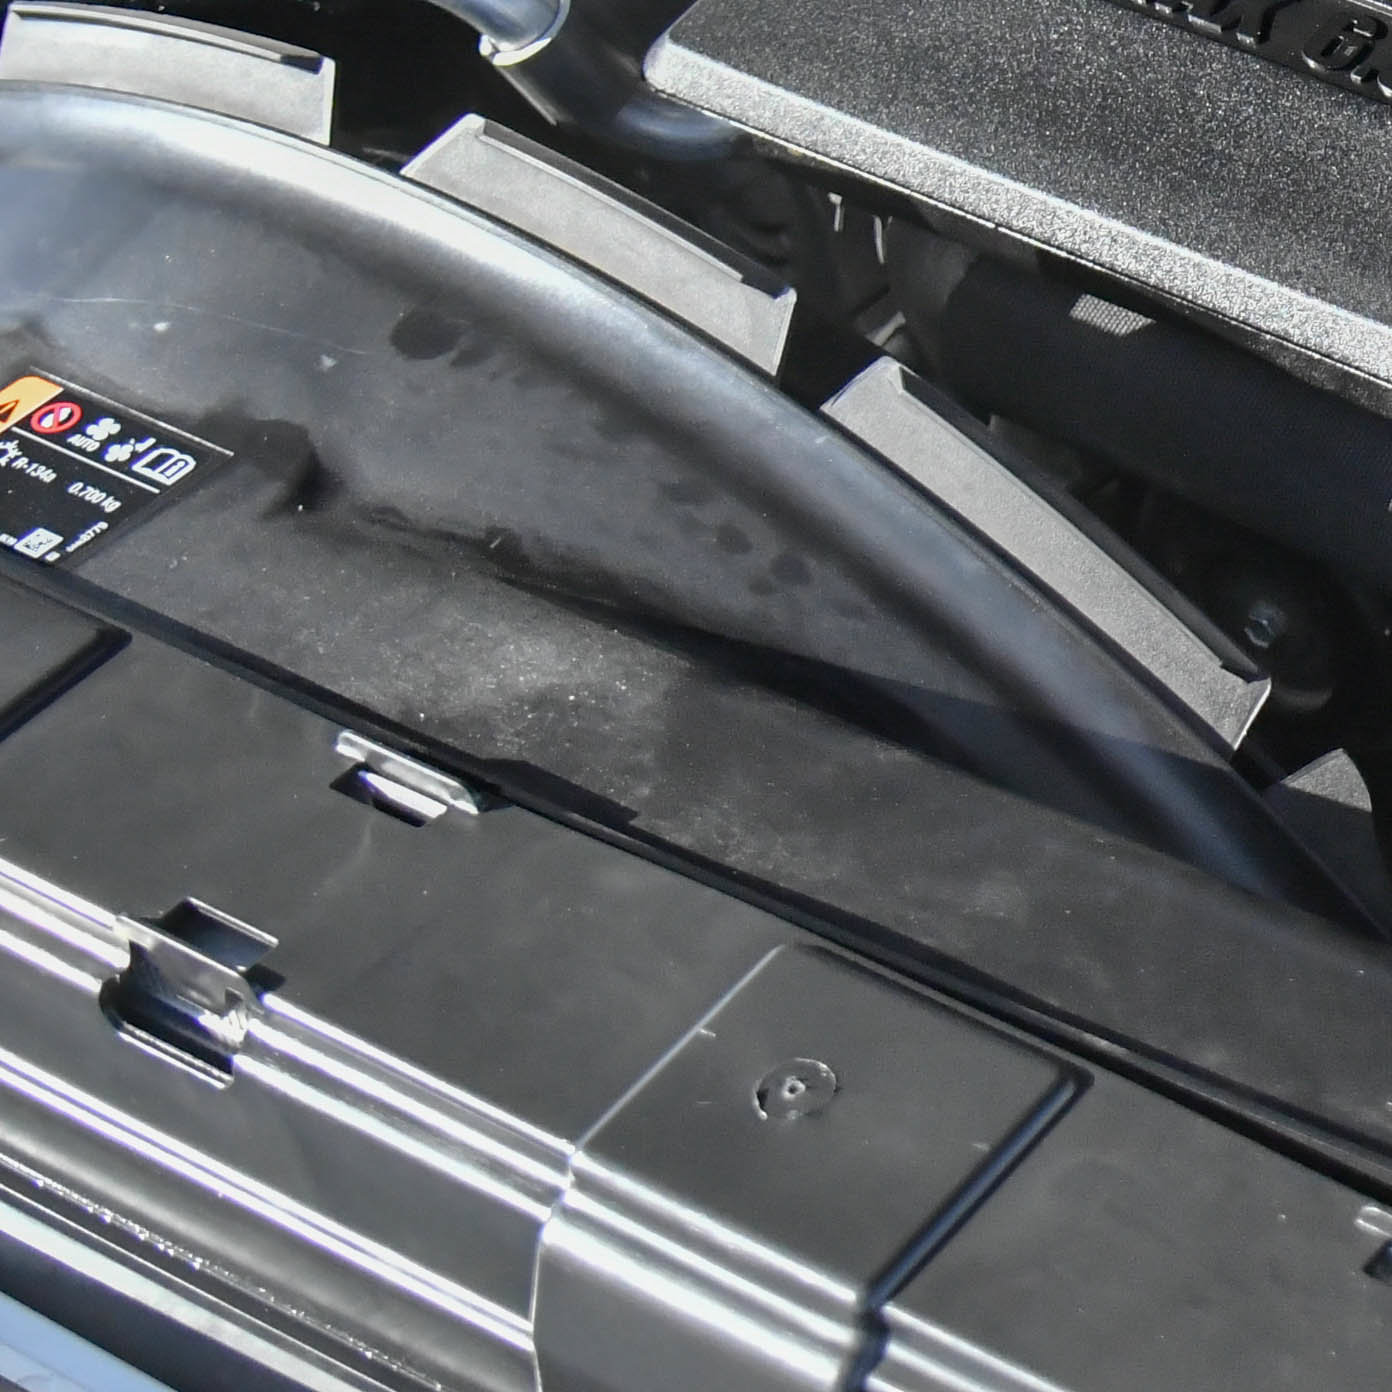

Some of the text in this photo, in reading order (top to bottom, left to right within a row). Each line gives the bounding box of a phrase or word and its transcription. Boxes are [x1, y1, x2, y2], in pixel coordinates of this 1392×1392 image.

[67, 434, 100, 452] AUTO
[12, 456, 122, 513] R-134a 0.700 kg
